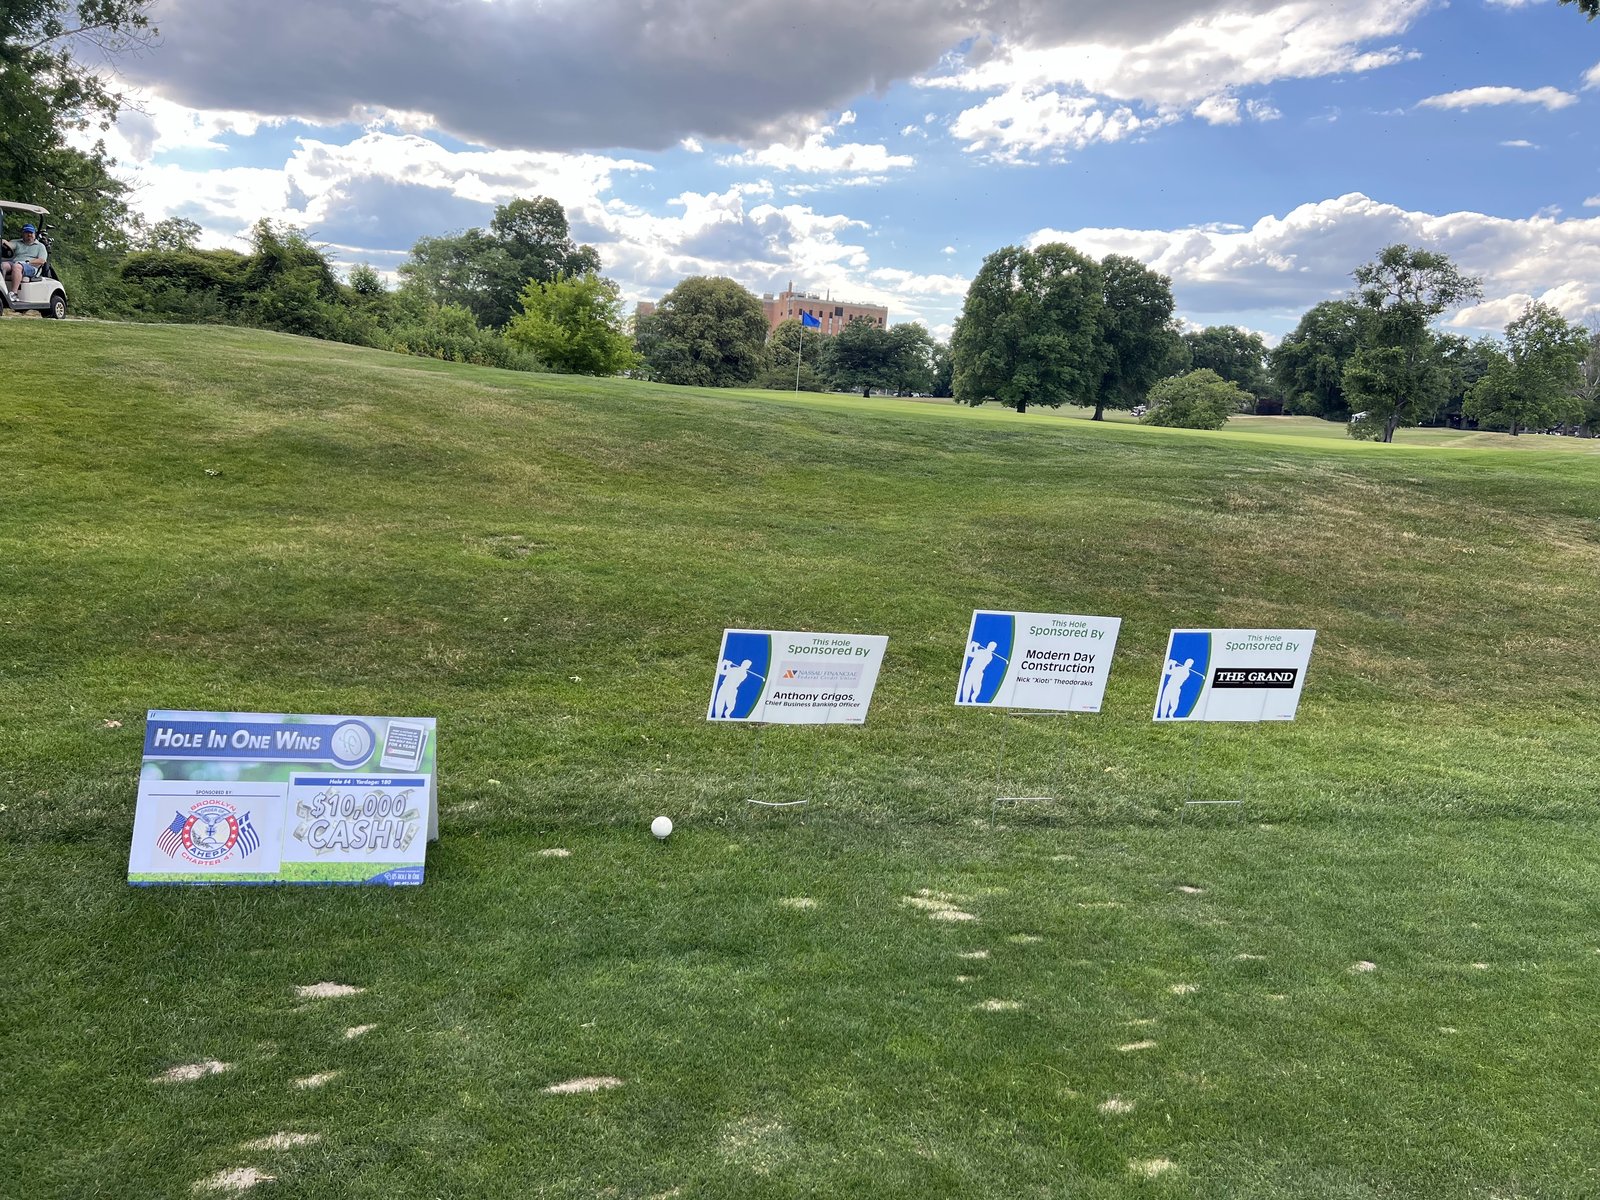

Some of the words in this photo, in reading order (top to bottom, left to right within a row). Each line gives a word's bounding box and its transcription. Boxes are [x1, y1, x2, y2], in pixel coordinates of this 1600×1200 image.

[1052, 620, 1068, 628] This
[1030, 626, 1088, 638] Sponsored
[1091, 629, 1105, 640] By
[788, 644, 852, 656] Sponsored
[855, 647, 871, 657] By
[1225, 641, 1283, 652] Sponsored
[1285, 642, 1299, 652] By
[1026, 650, 1071, 661] Modern
[1073, 652, 1096, 664] Day
[1021, 661, 1095, 674] Construction
[1054, 678, 1094, 687] Theodorakis
[1217, 672, 1246, 681] THE
[1247, 672, 1294, 682] GRAND
[773, 691, 819, 702] Anthony
[821, 692, 856, 702] Grigos,
[190, 800, 236, 811] BROOKLYN
[310, 792, 406, 820] $10,000
[308, 819, 405, 850] CASH!
[181, 851, 221, 866] CHAPTER
[189, 847, 228, 858] AHEPA
